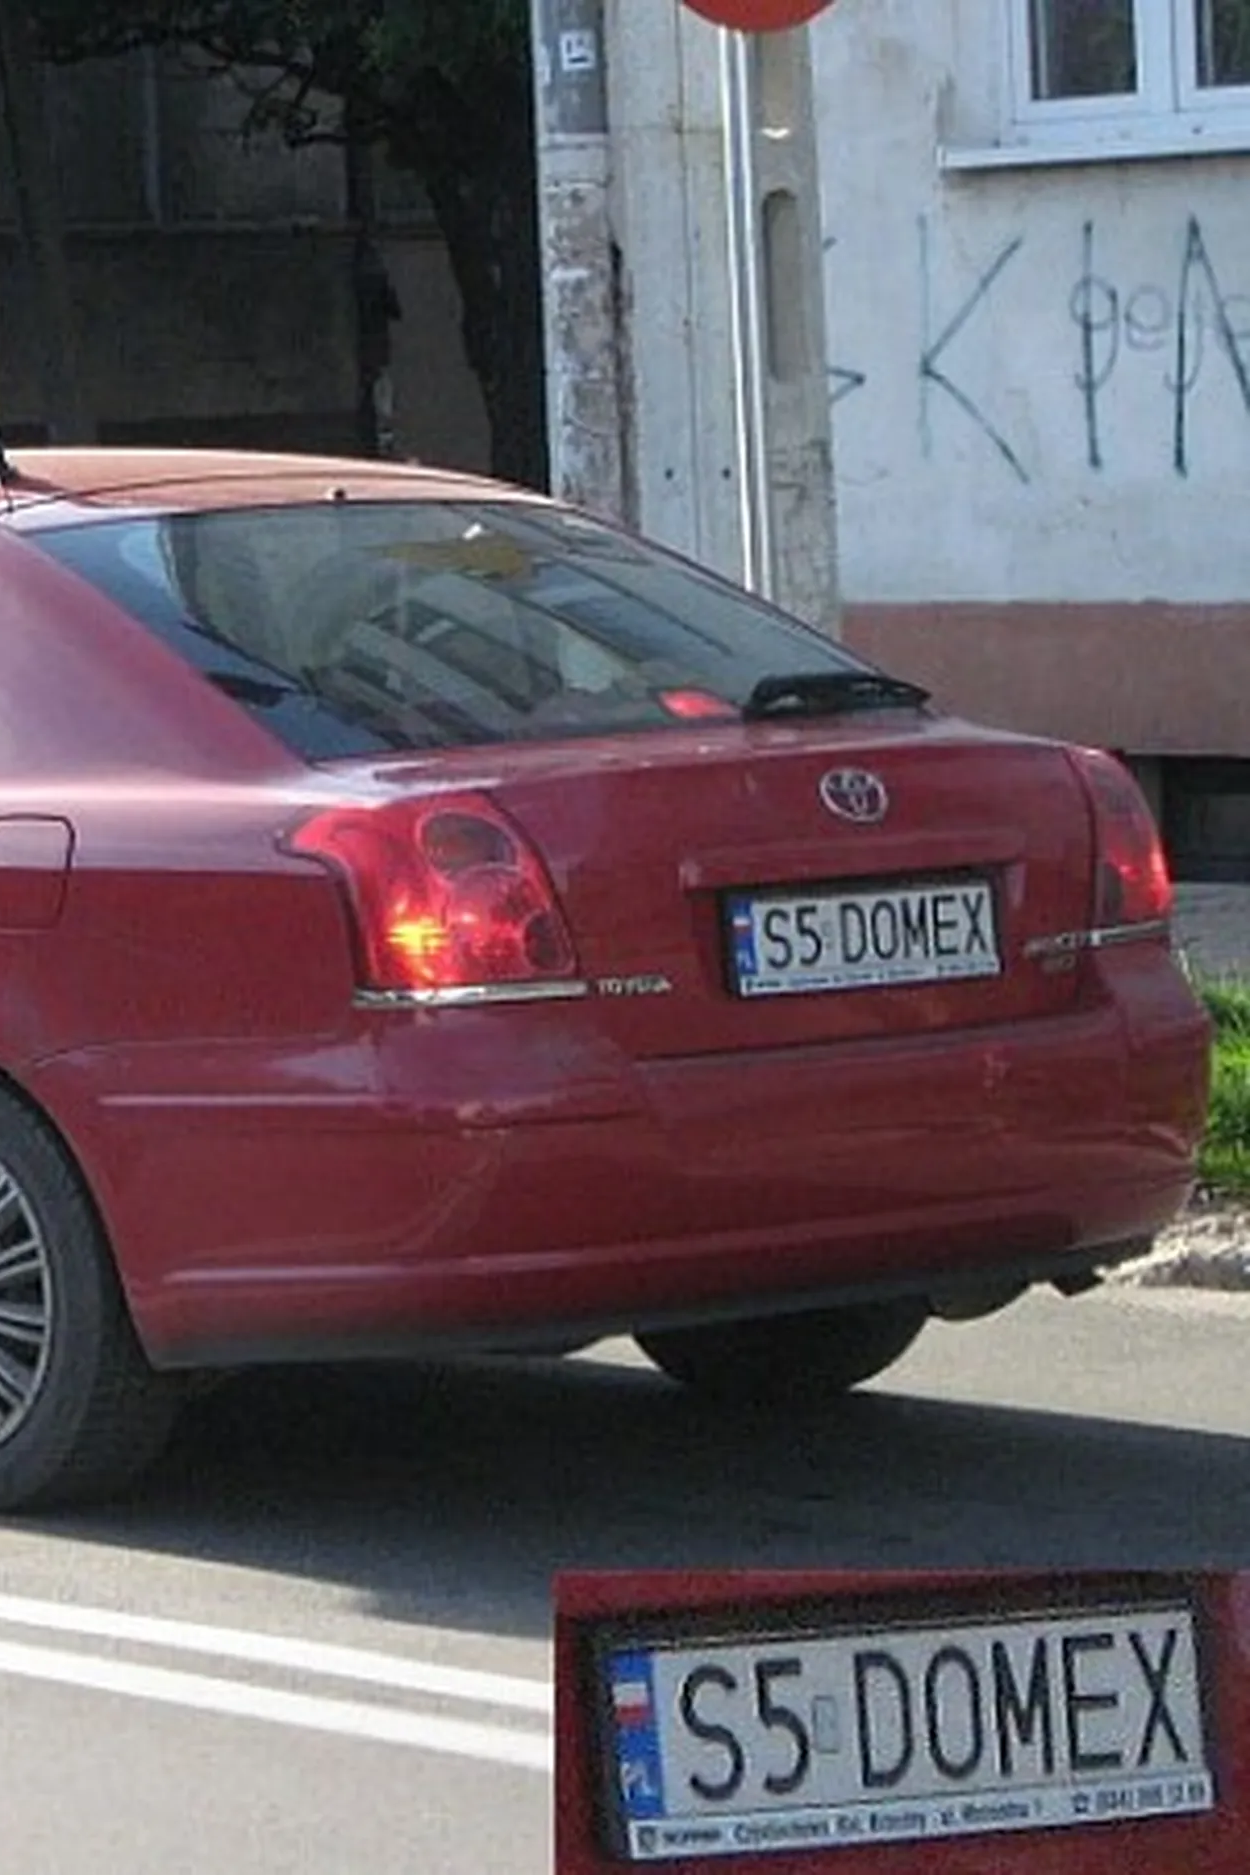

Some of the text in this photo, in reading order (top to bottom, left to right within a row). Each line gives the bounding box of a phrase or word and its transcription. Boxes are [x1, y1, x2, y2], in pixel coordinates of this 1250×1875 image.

[763, 892, 988, 969] S5 DOMEX
[680, 1628, 1188, 1800] S5 DOMEX
